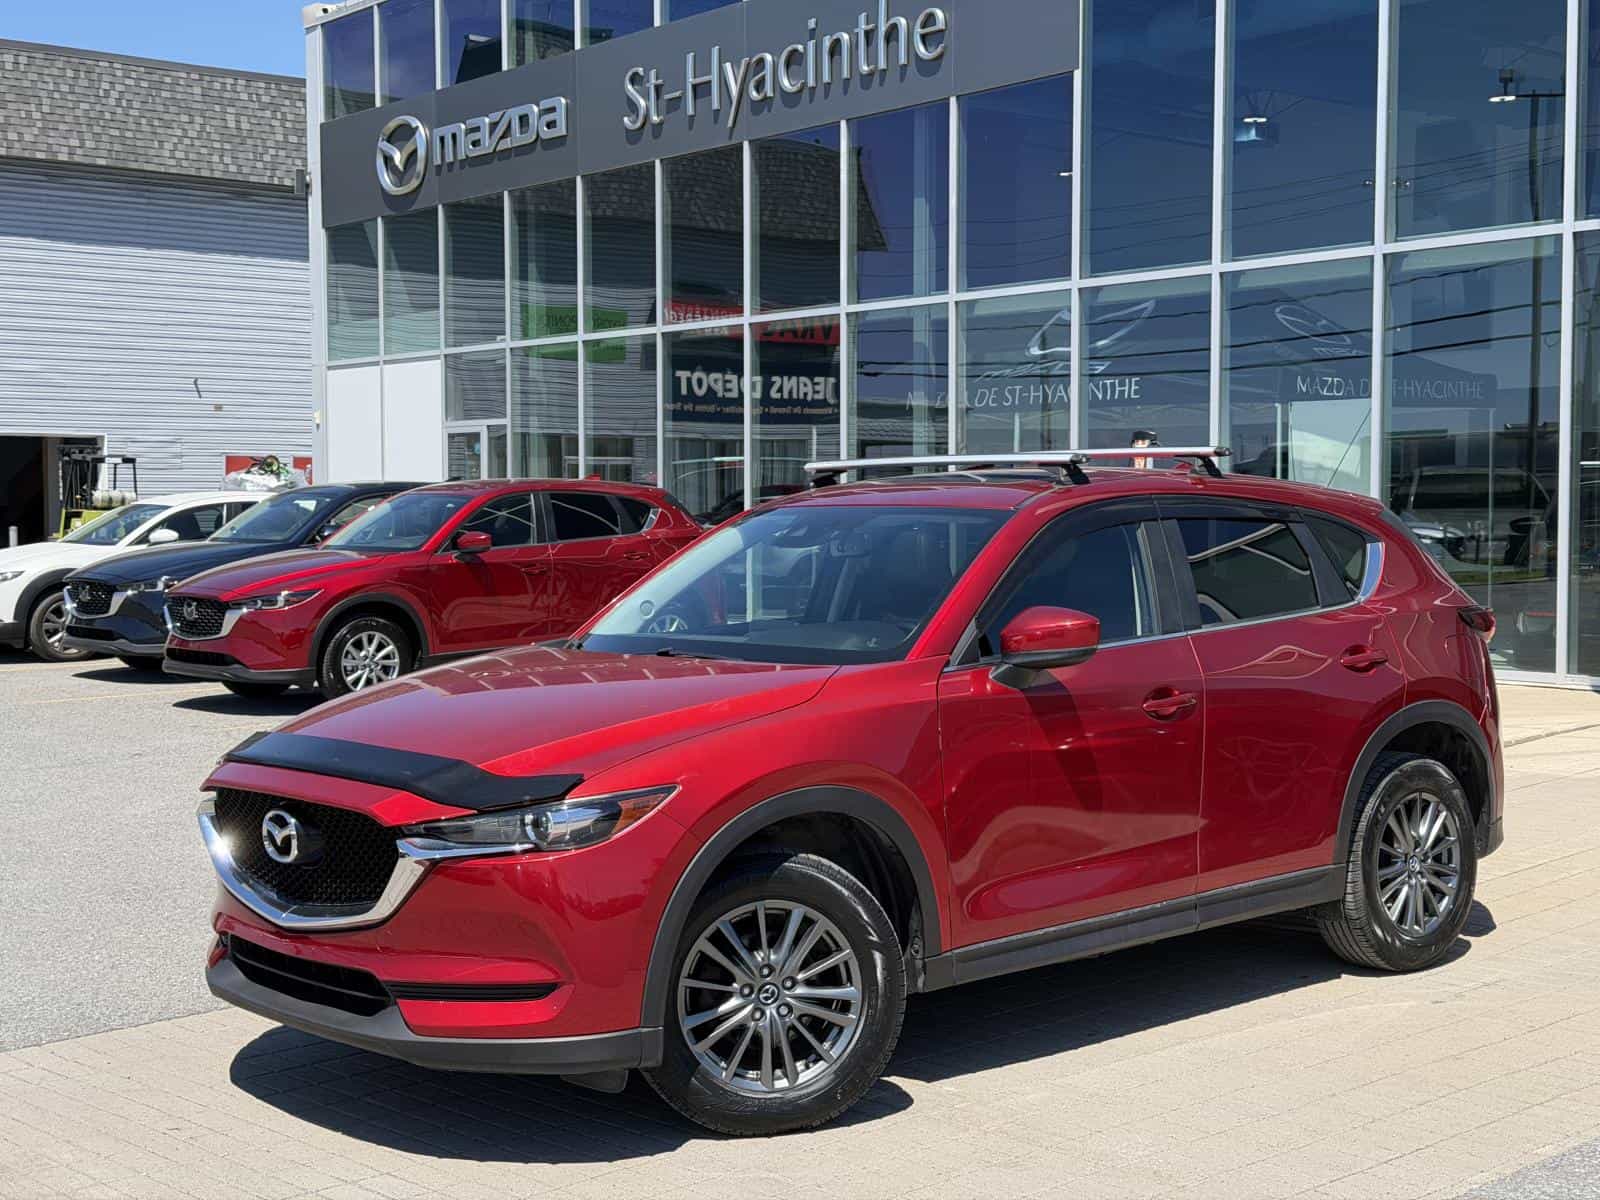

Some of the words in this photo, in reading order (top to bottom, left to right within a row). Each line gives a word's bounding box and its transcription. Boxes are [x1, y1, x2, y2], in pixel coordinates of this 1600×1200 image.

[623, 0, 946, 130] St-Hyacinthe
[975, 387, 998, 408] DE
[1002, 377, 1141, 406] ST-HYANTHE
[1296, 375, 1355, 396] MAZDA
[1391, 378, 1486, 401] T-HYACINTHE
